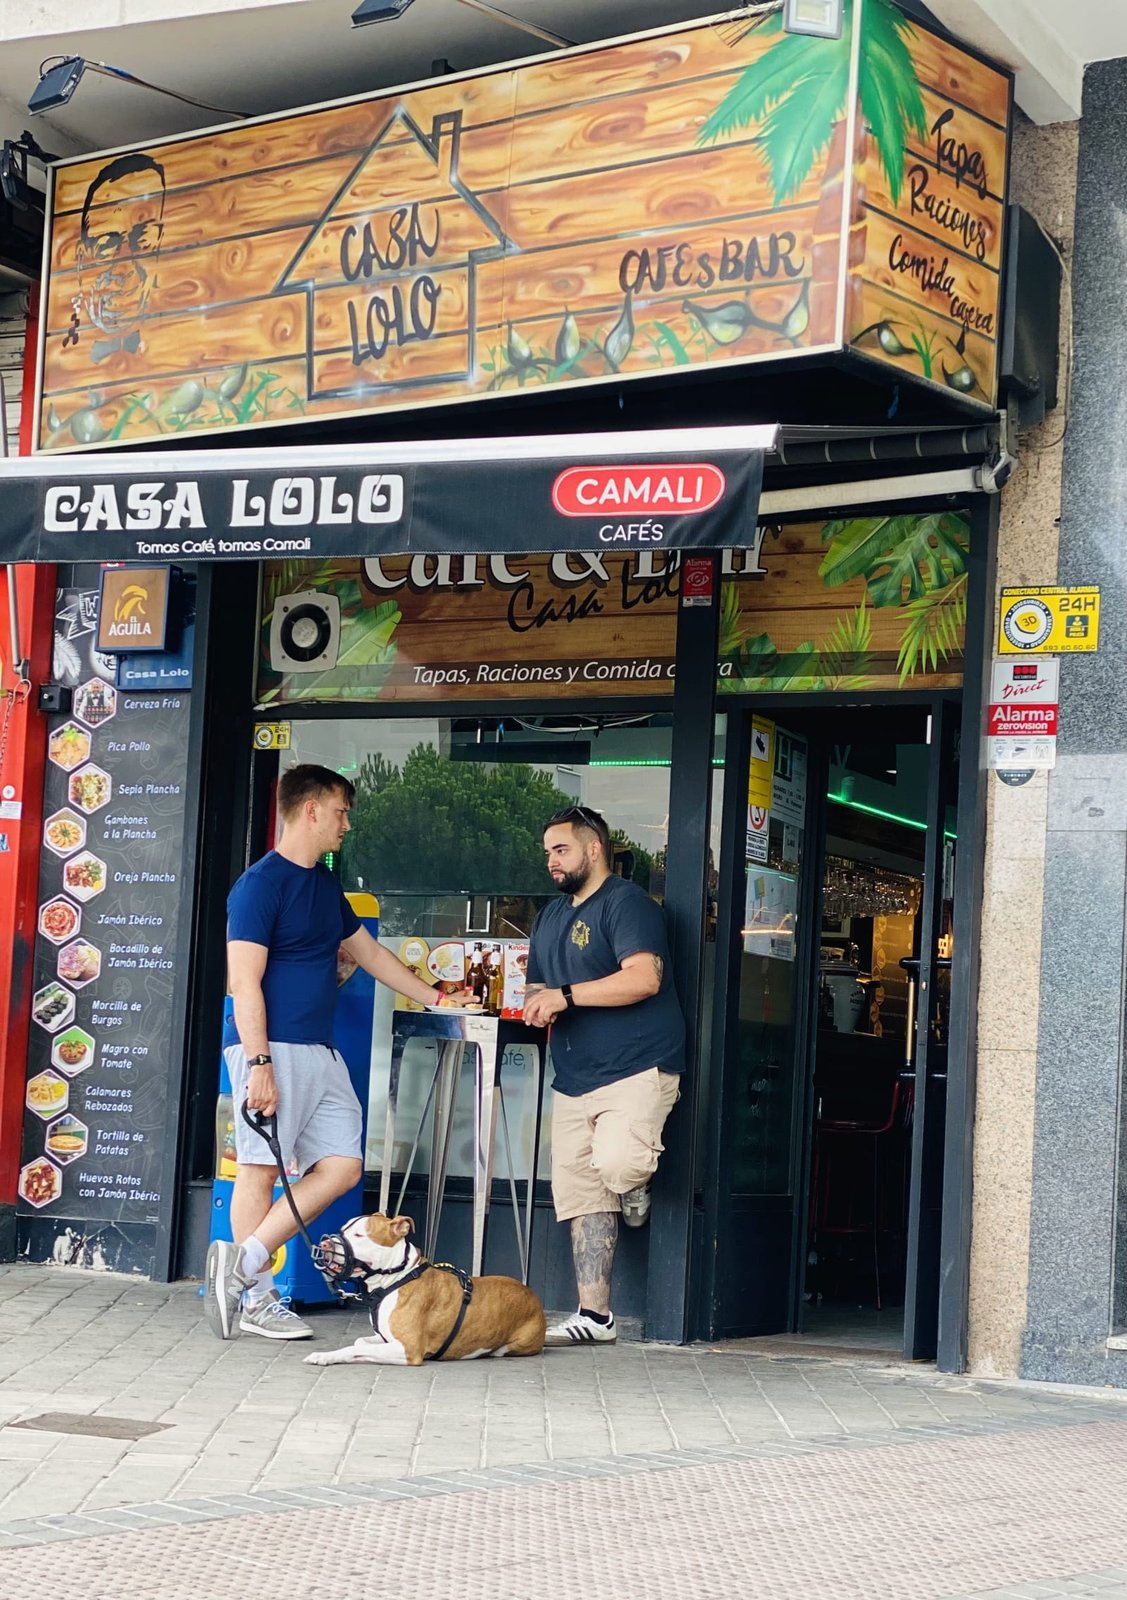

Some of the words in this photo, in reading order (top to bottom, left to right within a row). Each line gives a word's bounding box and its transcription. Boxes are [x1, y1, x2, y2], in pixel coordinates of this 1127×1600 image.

[931, 108, 990, 200] Tapas
[907, 164, 988, 259] Raciones
[340, 202, 441, 282] CASA
[718, 230, 805, 283] BAR
[888, 234, 955, 298] Comida
[348, 275, 442, 367] LOLO
[575, 476, 703, 506] CAMALI
[44, 481, 208, 532] CASA
[229, 473, 404, 527] LOLO
[599, 519, 664, 542] CAFÉS
[136, 540, 179, 554] Tomas
[181, 538, 216, 554] Café,
[218, 539, 262, 553] tomas
[263, 537, 311, 551] Camali
[506, 582, 604, 633] Casa
[621, 552, 680, 610] Lol
[1003, 588, 1040, 596] CONECTADO
[1040, 587, 1068, 595] CENTRAL
[1069, 585, 1100, 594] ALARMAS
[1059, 597, 1096, 612] 24H
[1022, 615, 1037, 627] 3D
[126, 670, 157, 679] Casa
[160, 668, 189, 677] Lolo
[413, 664, 470, 687] Tapas,
[476, 661, 563, 682] Raciones
[567, 665, 579, 684] y
[583, 659, 657, 680] Comida
[1002, 679, 1048, 699] Direct
[124, 699, 160, 709] Cerveza
[162, 698, 181, 709] Fría
[992, 706, 1055, 721] Alarma
[997, 722, 1048, 730] zerovision
[107, 742, 126, 751] Pica
[129, 742, 150, 751] Pollo
[118, 784, 143, 795] Sepia
[145, 784, 180, 795] Plancha
[104, 815, 148, 826] Gambones
[103, 831, 109, 839] a
[111, 830, 120, 839] la
[122, 829, 157, 840] Plancha
[114, 872, 139, 883] Oreja
[141, 872, 176, 882] Plancha
[98, 914, 126, 925] Jamón
[129, 914, 162, 926] Ibérico
[110, 943, 149, 954] Bocadillo
[152, 944, 163, 954] de
[108, 958, 136, 969] Jamón
[138, 958, 173, 969] Ibérico
[92, 1000, 130, 1012] Morcilla
[133, 1001, 142, 1012] de
[92, 1014, 122, 1026] Burgos
[101, 1043, 129, 1056] Magro
[131, 1046, 148, 1055] con
[100, 1058, 132, 1069] Tomate
[501, 1047, 526, 1070] afé,
[85, 1086, 132, 1098] Calamares
[85, 1100, 133, 1113] Rebozados
[96, 1130, 131, 1142] Tortilla
[132, 1132, 144, 1142] de
[96, 1144, 129, 1156] Patatas
[79, 1172, 113, 1184] Huevos
[116, 1174, 142, 1186] Rotos
[79, 1188, 95, 1198] con
[98, 1188, 127, 1199] Jamón
